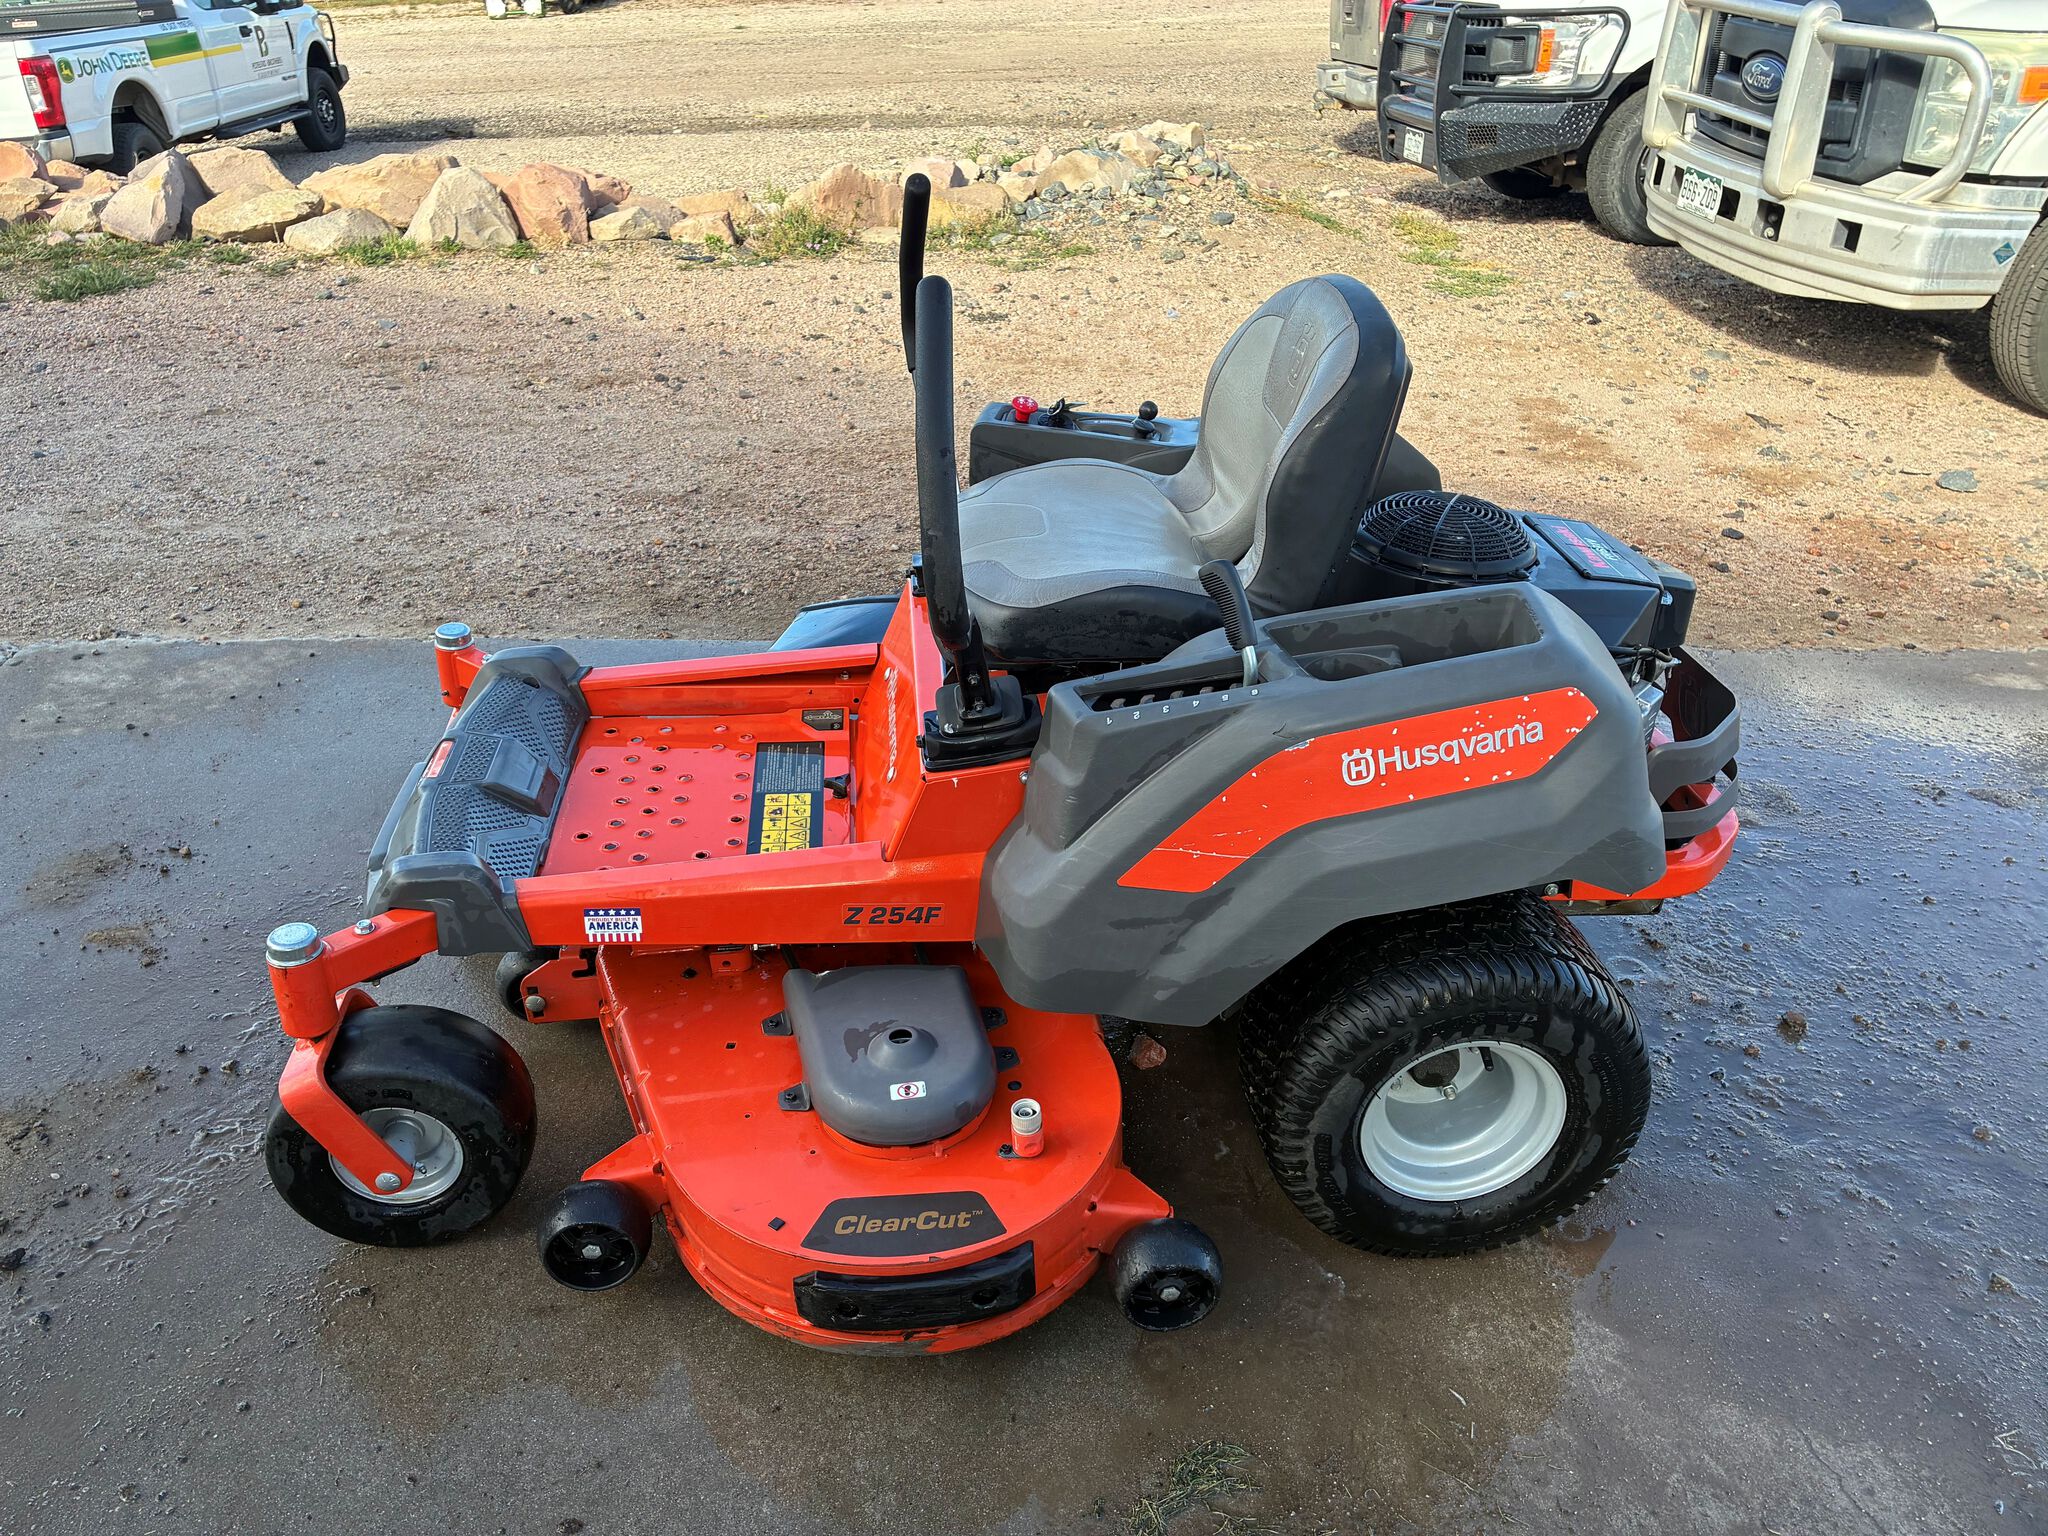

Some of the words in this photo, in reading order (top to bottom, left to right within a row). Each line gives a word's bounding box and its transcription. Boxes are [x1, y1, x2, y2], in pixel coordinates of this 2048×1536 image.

[77, 56, 113, 78] JOHN
[109, 51, 150, 71] DEERE
[1746, 63, 1775, 89] Ford
[1162, 705, 1170, 713] 3
[1192, 700, 1200, 708] 4
[1133, 710, 1141, 720] 2
[1106, 717, 1113, 725] 1
[1378, 721, 1544, 776] Husqvarna
[843, 906, 864, 925] Z
[868, 906, 942, 925] 254F
[588, 921, 638, 930] AMERICA
